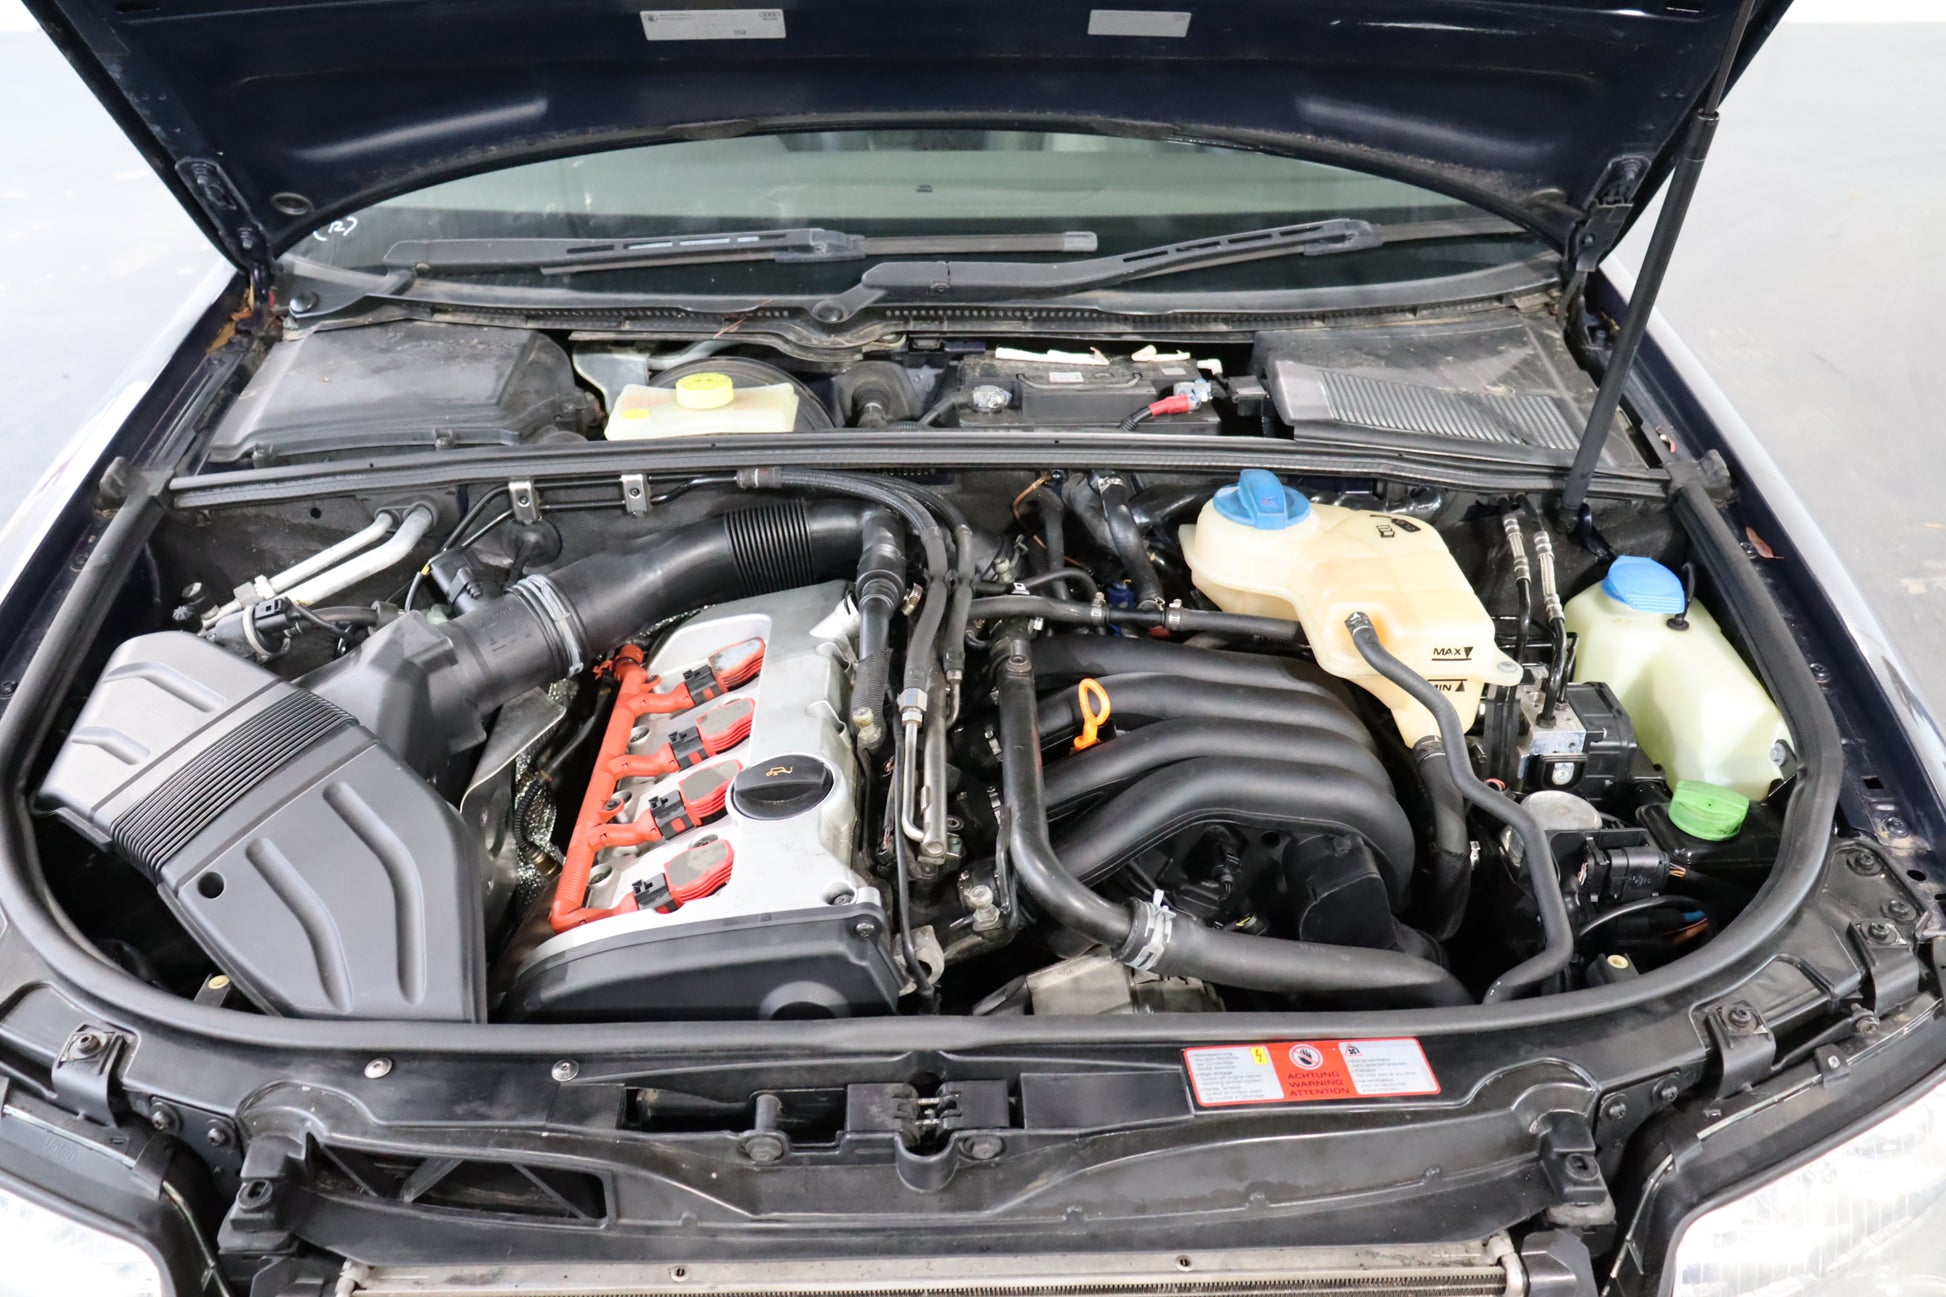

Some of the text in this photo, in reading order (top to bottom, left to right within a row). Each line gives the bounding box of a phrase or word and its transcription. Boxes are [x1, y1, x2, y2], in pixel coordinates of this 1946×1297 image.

[1433, 648, 1462, 656] MAX
[1288, 1071, 1340, 1079] ACHTUNG
[1289, 1079, 1343, 1088] WARNING
[1290, 1087, 1350, 1096] ATTENTION
